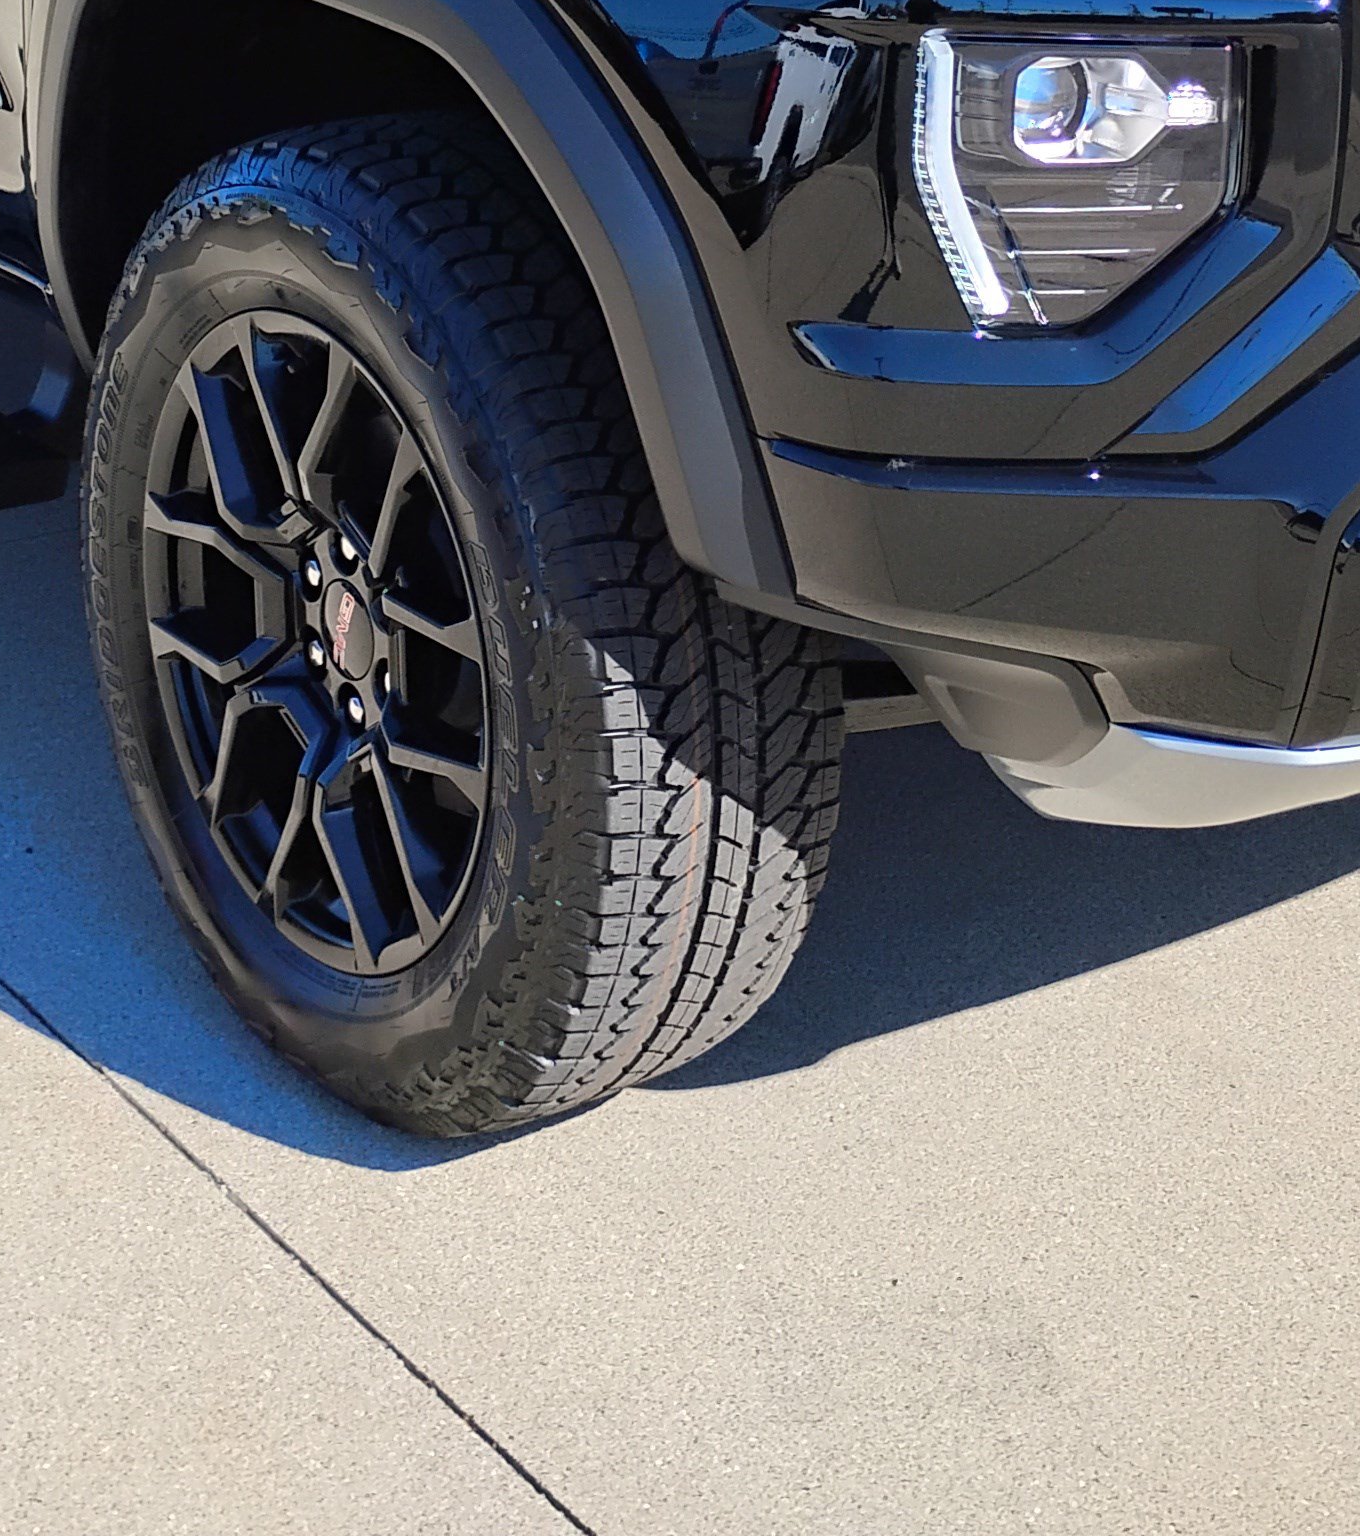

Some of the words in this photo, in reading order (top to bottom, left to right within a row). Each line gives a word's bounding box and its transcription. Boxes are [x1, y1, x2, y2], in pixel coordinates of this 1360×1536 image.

[90, 350, 148, 787] BRIDGESTONE
[333, 592, 355, 670] GMC
[468, 541, 519, 925] DUELER
